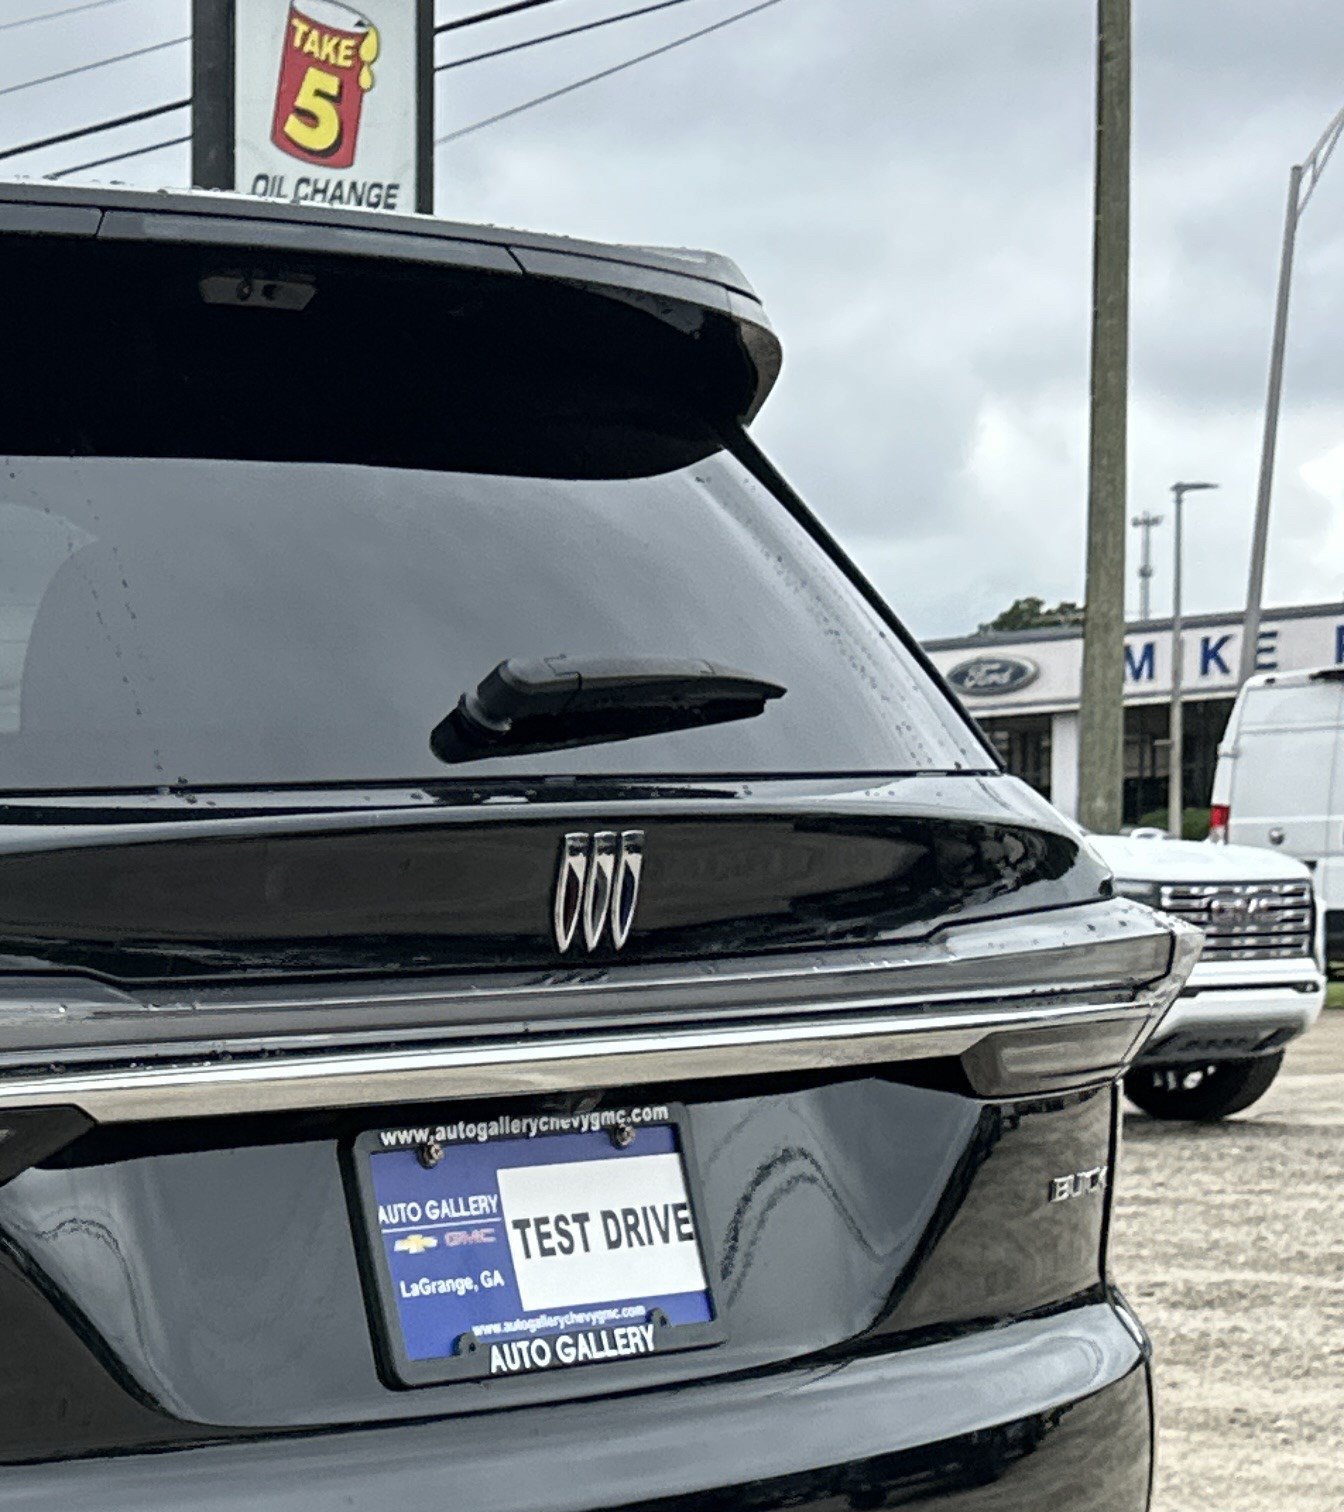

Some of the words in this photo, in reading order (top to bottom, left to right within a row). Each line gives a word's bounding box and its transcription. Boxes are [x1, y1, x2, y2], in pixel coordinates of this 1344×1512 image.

[291, 18, 356, 68] TAKE
[282, 67, 342, 156] 5
[252, 173, 289, 201] OIL
[293, 176, 400, 210] CHANGE
[1124, 630, 1278, 682] MKE
[379, 1104, 669, 1147] www.autogallerychevygmc.com
[378, 1205, 422, 1225] AUTO
[425, 1193, 499, 1219] GALLERY
[512, 1211, 591, 1260] TEST
[599, 1201, 695, 1251] DRIVE
[444, 1227, 497, 1248] GMC
[399, 1276, 480, 1299] LaGrange,
[480, 1269, 505, 1288] GA
[489, 1337, 552, 1374] AUTO
[554, 1323, 655, 1364] GALLERY
